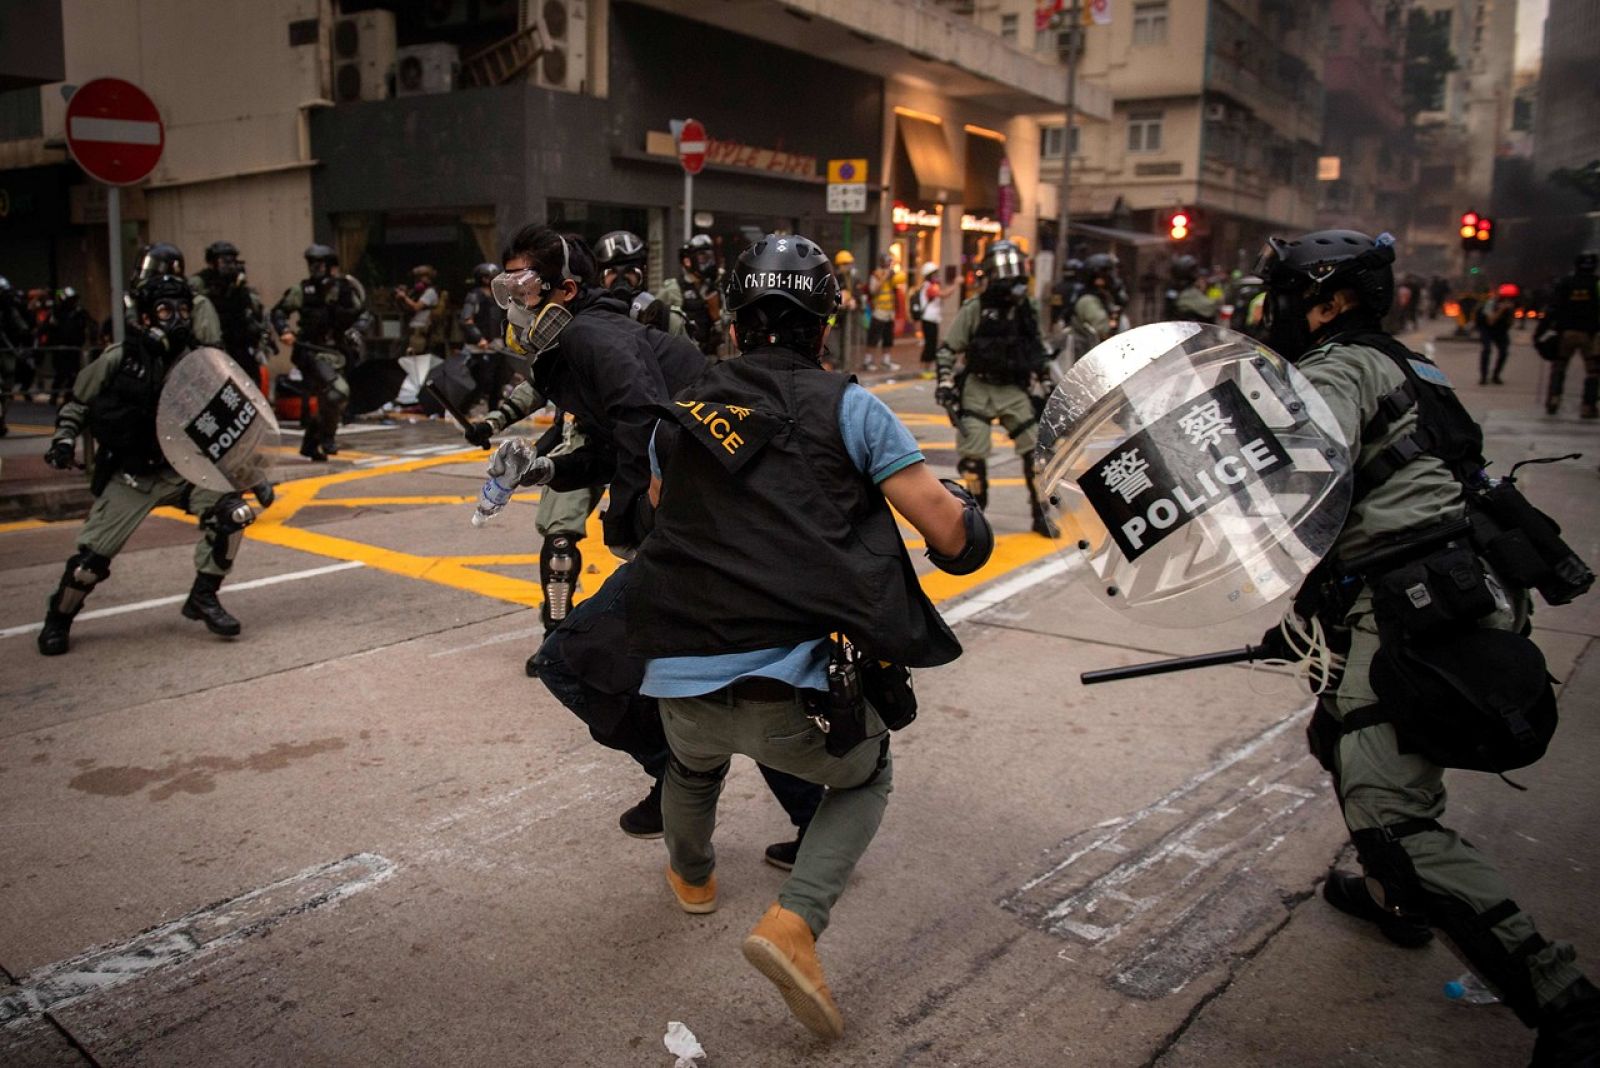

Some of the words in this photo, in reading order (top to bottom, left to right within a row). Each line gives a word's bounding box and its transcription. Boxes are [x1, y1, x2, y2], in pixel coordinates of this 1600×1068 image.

[209, 402, 256, 459] POLICE
[1101, 399, 1236, 504] 警察
[1121, 438, 1279, 550] POLICE
